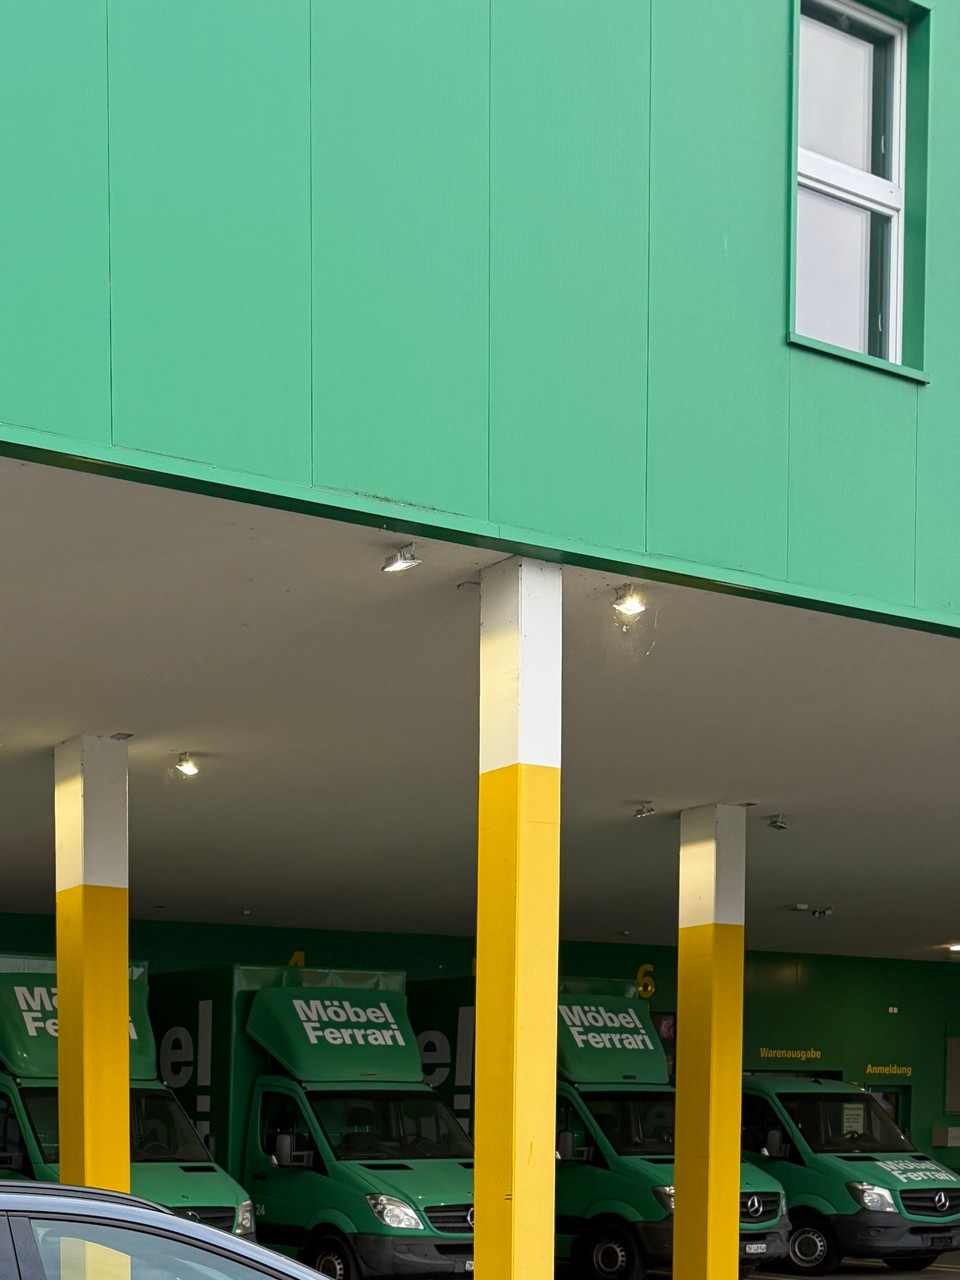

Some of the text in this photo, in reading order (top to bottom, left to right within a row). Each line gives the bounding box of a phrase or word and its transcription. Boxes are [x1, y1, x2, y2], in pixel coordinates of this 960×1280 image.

[637, 964, 655, 998] 6
[292, 999, 395, 1024] Möbel
[558, 1005, 643, 1028] Möbel
[302, 1021, 406, 1046] Ferrari
[569, 1026, 654, 1050] Ferrari
[760, 1047, 822, 1060] Warenausgabe
[866, 1064, 912, 1077] Anmeldung
[875, 1160, 942, 1172] Möbel
[891, 1170, 957, 1183] Ferrari
[256, 1204, 265, 1216] 24
